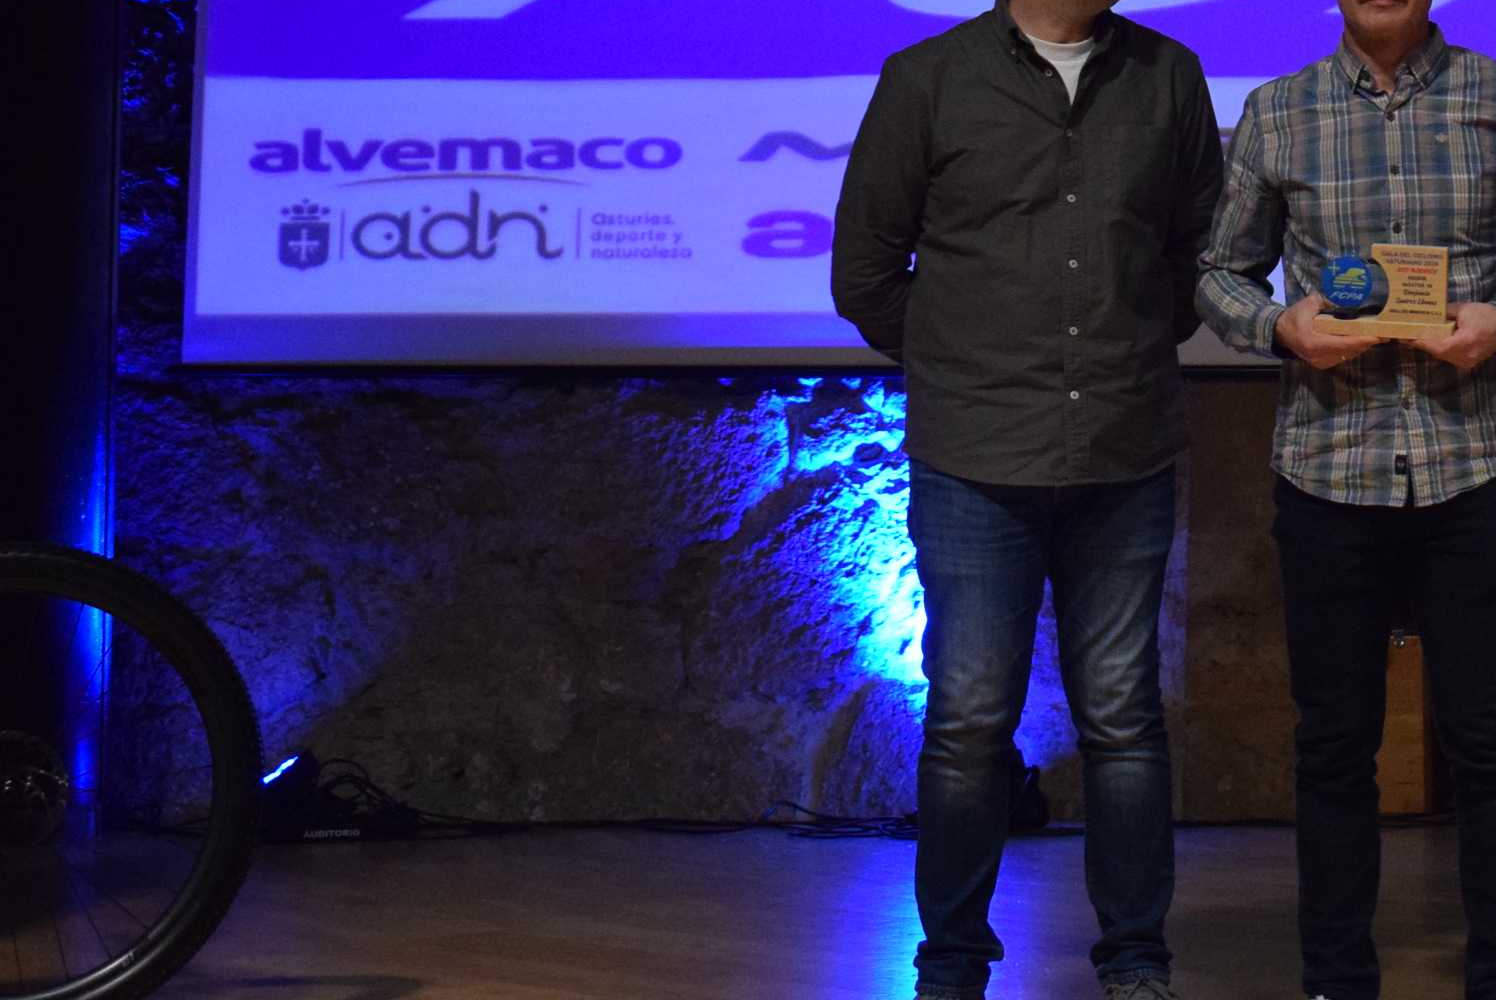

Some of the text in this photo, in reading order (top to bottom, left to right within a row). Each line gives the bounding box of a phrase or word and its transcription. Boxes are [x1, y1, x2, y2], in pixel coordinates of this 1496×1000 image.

[249, 128, 684, 174] alvemaco
[590, 229, 683, 244] deporte y
[590, 245, 693, 259] naturaleza
[1329, 290, 1364, 300] FCPA
